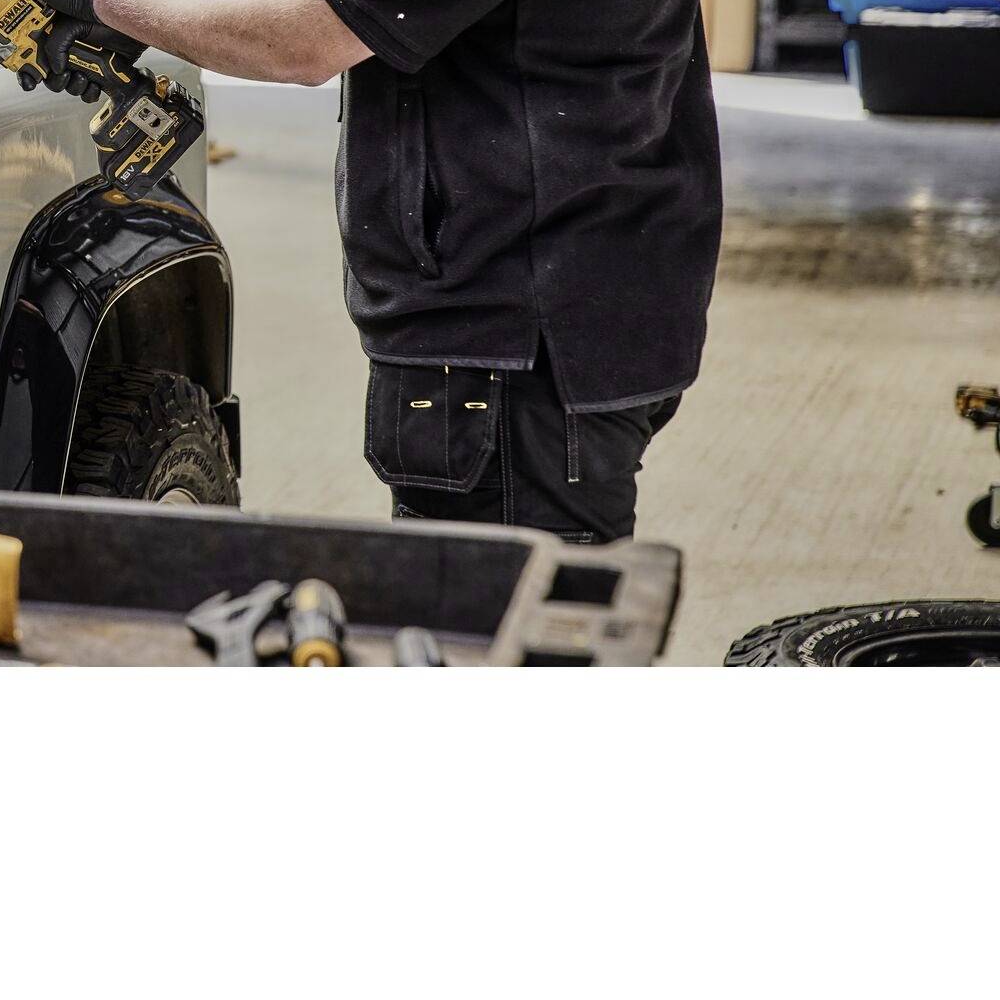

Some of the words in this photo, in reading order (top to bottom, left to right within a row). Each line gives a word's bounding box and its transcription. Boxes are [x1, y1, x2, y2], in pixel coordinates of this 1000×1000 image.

[135, 137, 155, 158] DEWA
[120, 165, 135, 181] 18V
[864, 608, 921, 623] T/A
